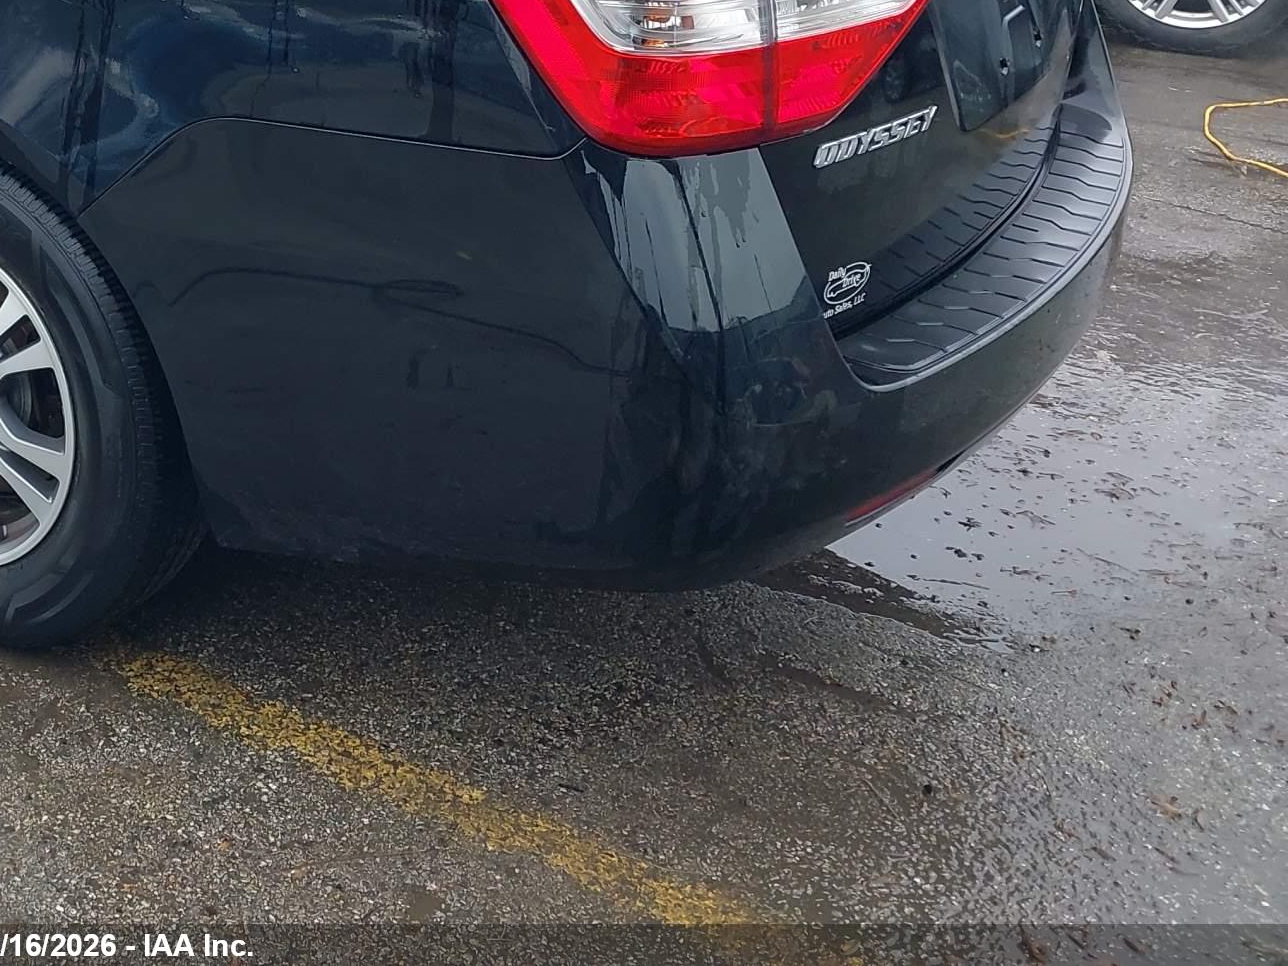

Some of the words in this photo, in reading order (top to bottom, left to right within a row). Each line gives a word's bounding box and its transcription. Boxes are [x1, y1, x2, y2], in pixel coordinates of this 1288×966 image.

[813, 106, 937, 169] ODYSSEY
[828, 267, 847, 281] Daily
[842, 273, 861, 288] Drive
[823, 309, 834, 319] uto
[853, 292, 866, 305] LLC
